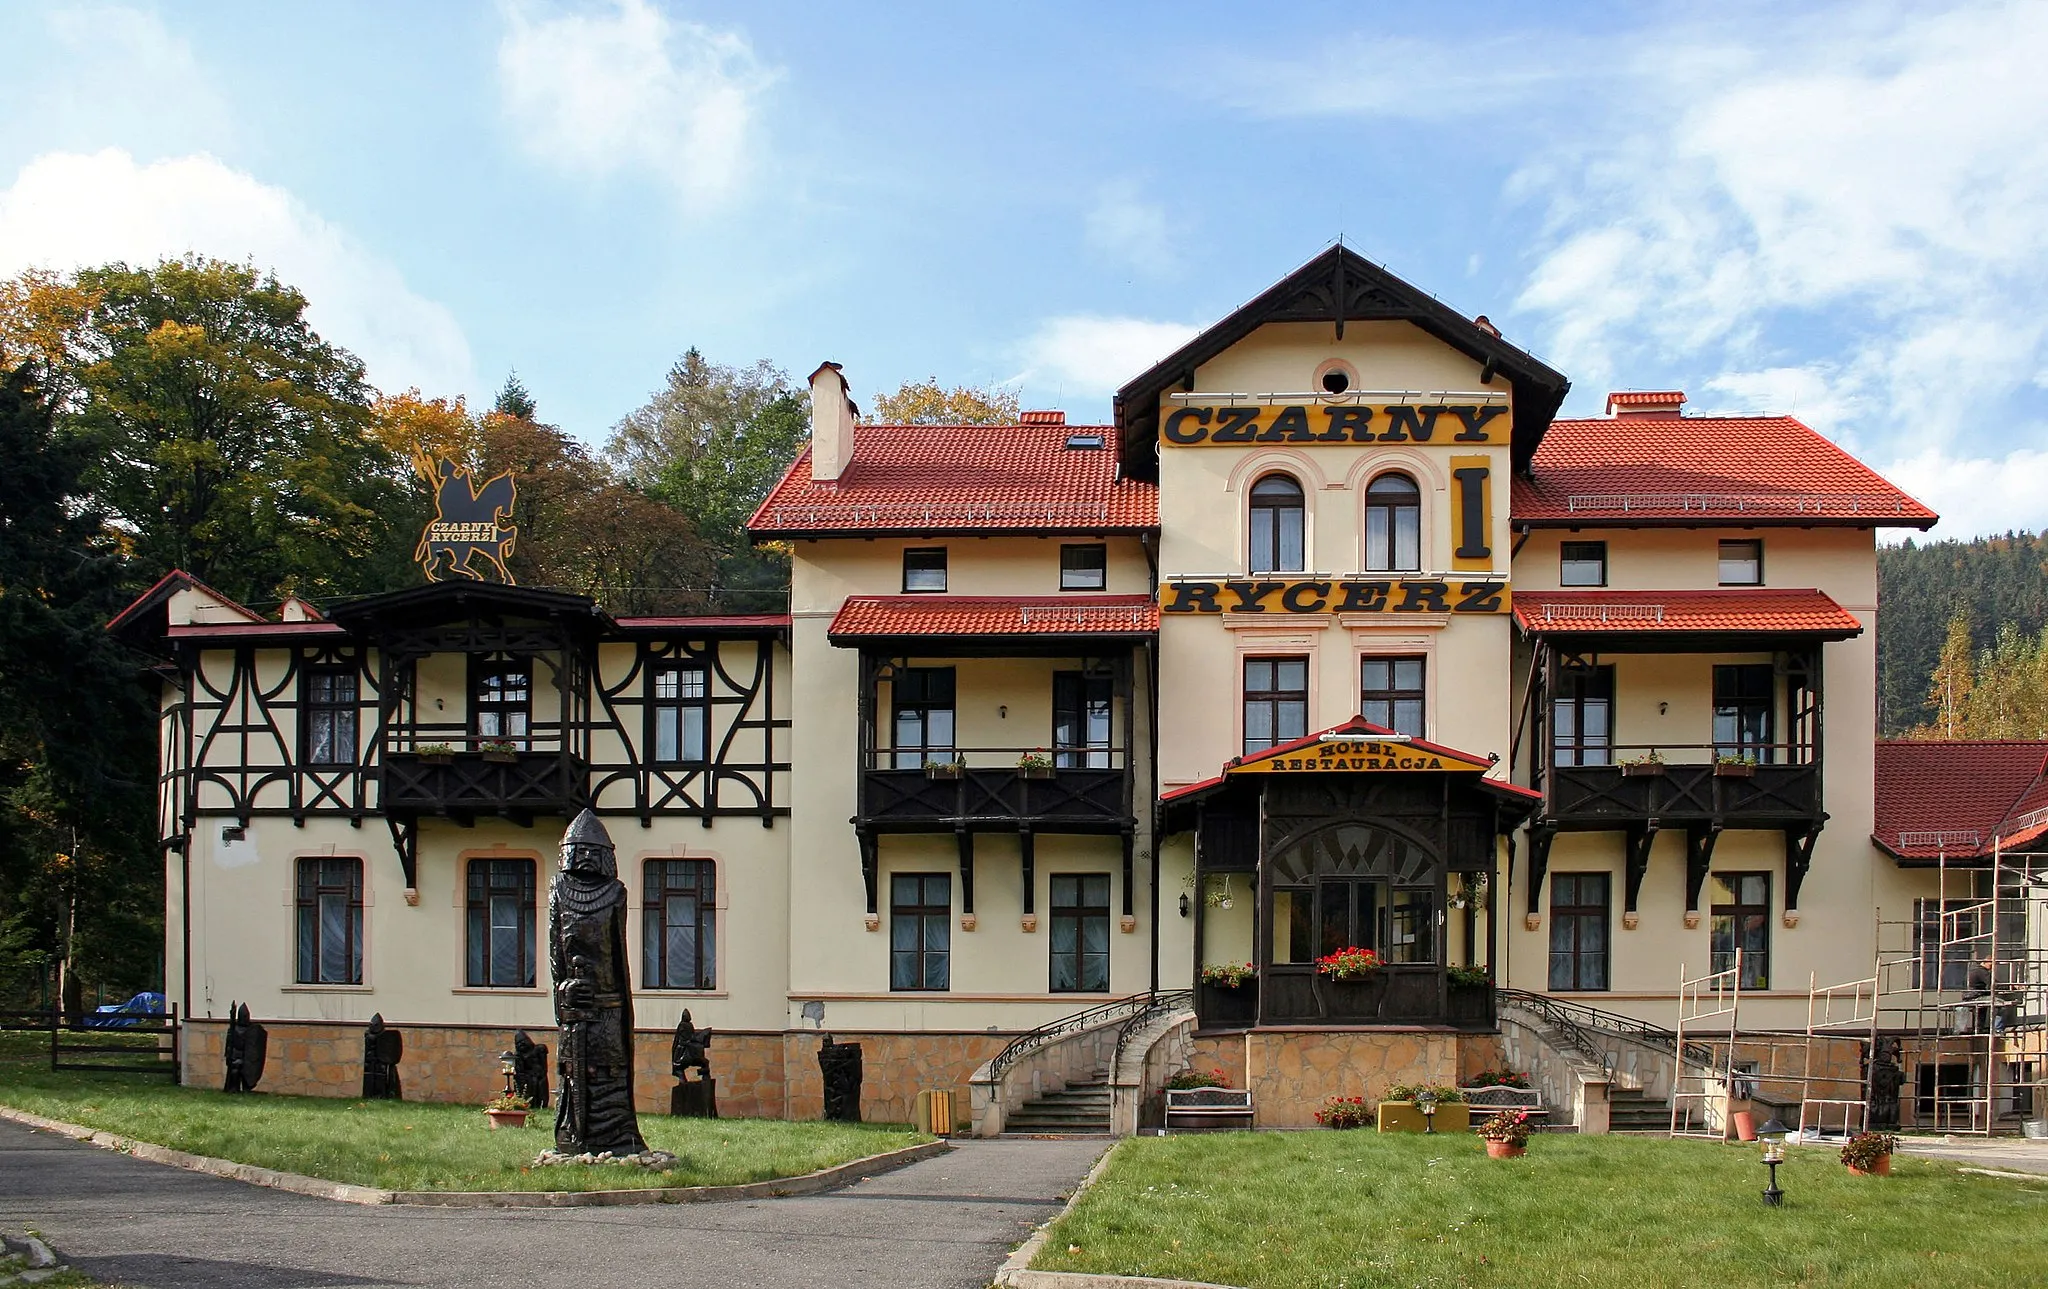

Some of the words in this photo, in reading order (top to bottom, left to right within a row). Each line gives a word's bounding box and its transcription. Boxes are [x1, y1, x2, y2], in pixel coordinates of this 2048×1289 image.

[1163, 405, 1509, 444] CZARNY
[1453, 467, 1491, 559] I
[430, 522, 494, 532] CZARNY
[430, 532, 491, 542] RYCERZ
[1163, 582, 1506, 613] RYCERZ
[1318, 741, 1397, 758] HOTEL
[1271, 757, 1443, 771] RESTAURACJA
